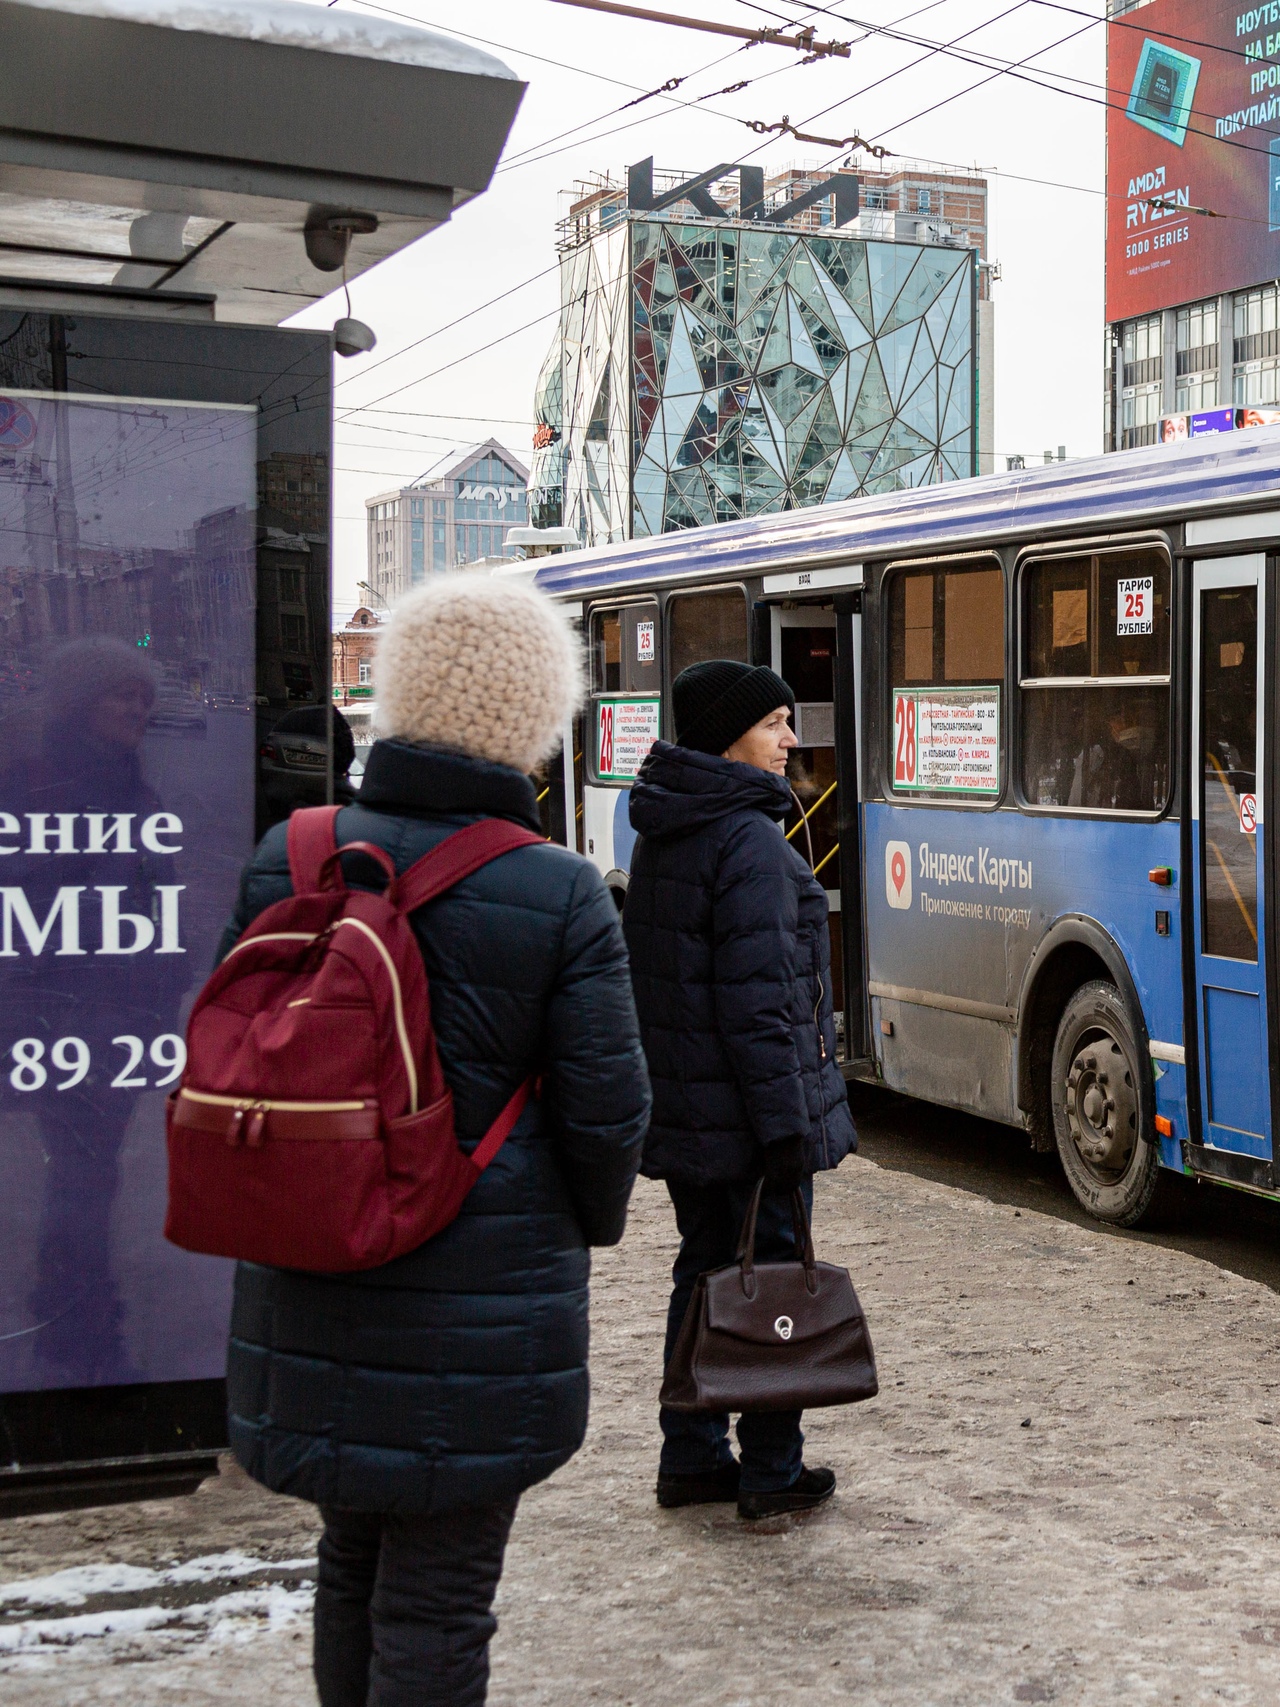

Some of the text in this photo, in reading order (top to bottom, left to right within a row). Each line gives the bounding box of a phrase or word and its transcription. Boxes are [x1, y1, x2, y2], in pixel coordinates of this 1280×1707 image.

[1245, 39, 1263, 65] НА
[1127, 168, 1162, 198] AMD
[1126, 185, 1190, 229] RYZEN
[1126, 226, 1189, 259] 5000 SERIES
[1119, 579, 1152, 592] ТАРИФ
[1125, 594, 1144, 617] 25
[638, 623, 653, 631] ТАРИФ
[641, 633, 651, 649] 25
[1119, 620, 1152, 634] РУБЛЕЙ
[600, 707, 613, 772] 28
[895, 696, 916, 782] 28
[919, 843, 1032, 893] Яндекс Карты
[0, 885, 187, 957] МЫ
[921, 892, 1031, 930] Приложение к городу
[10, 1033, 188, 1091] 89 29
